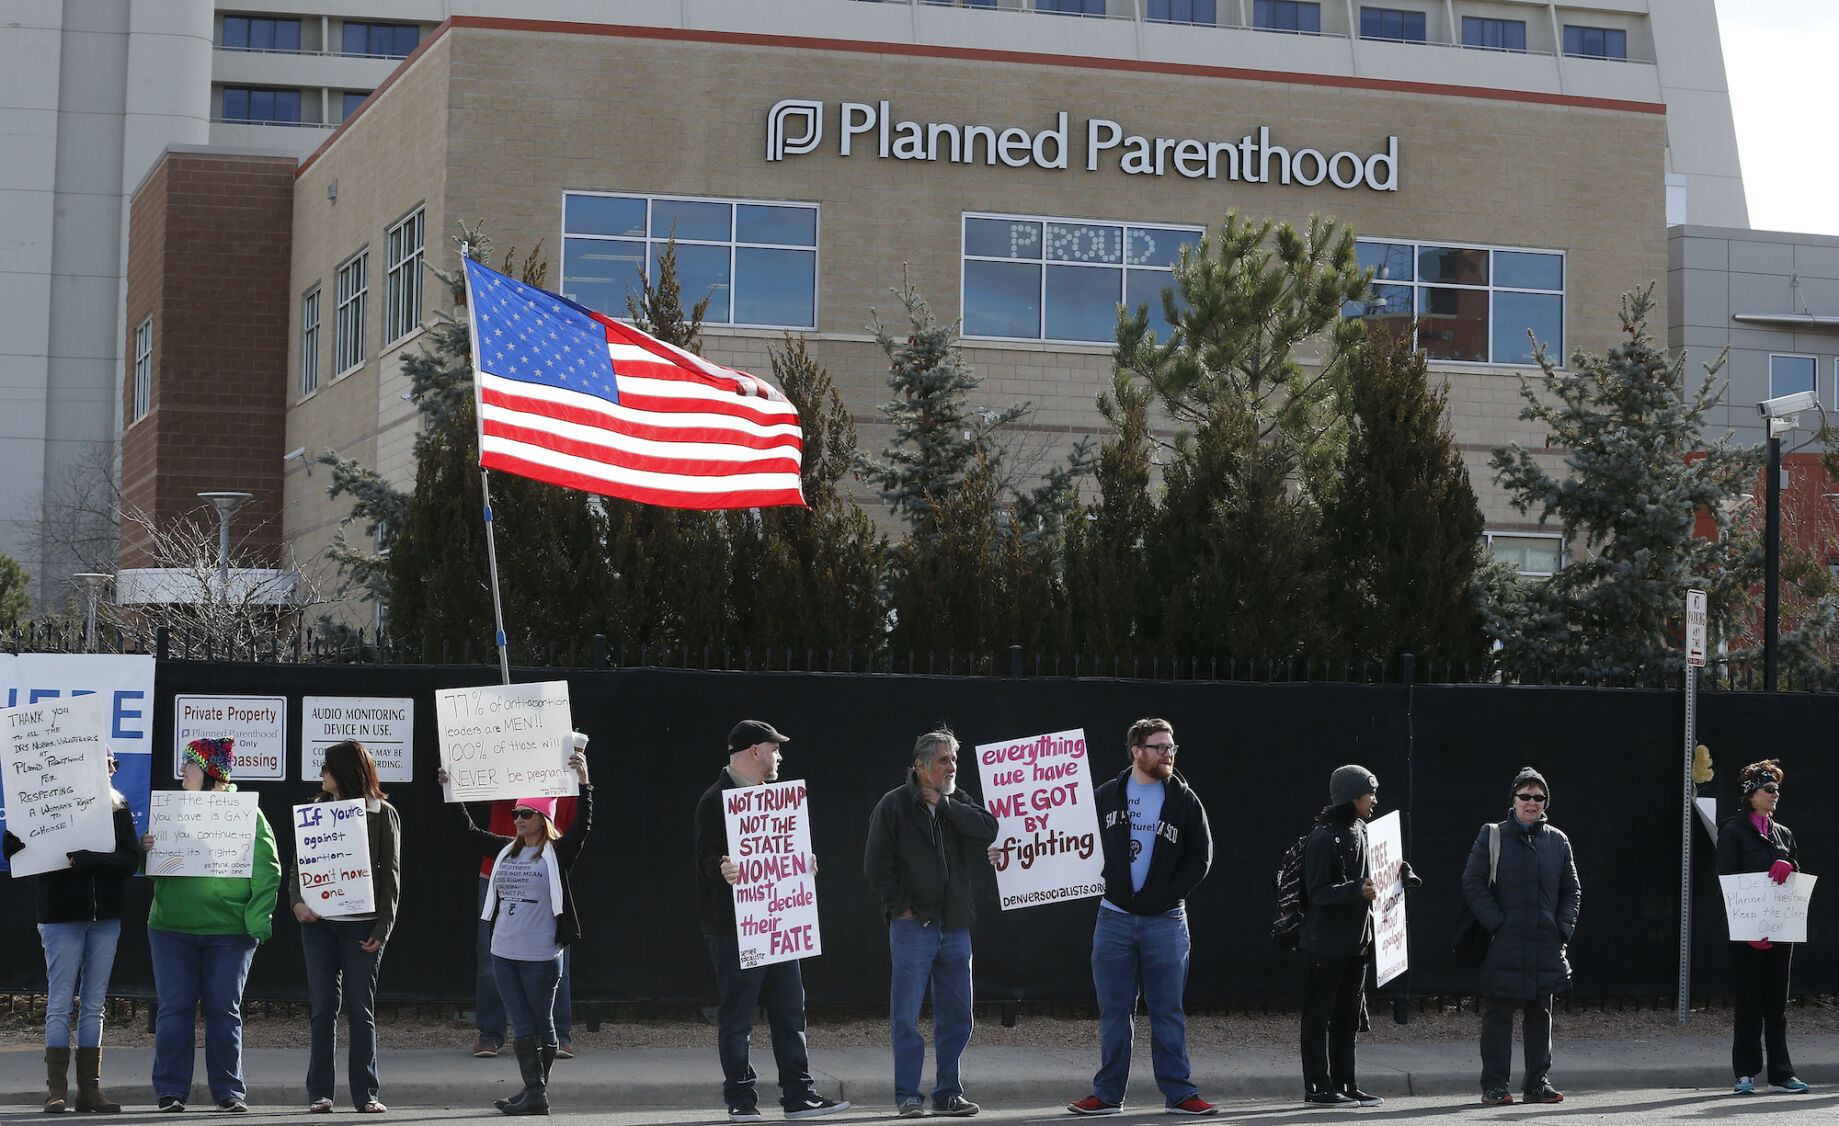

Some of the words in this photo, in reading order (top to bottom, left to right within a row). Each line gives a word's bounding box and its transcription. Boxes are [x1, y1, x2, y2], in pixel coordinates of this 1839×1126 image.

[839, 100, 1069, 169] Planned
[1086, 118, 1399, 192] Parenthood
[1010, 224, 1156, 265] PROUD
[1688, 611, 1706, 626] PARKING
[312, 707, 342, 720] AUDIO
[345, 708, 406, 721] MONITORING
[444, 690, 484, 718] 77%
[490, 696, 502, 713] of
[503, 697, 568, 711] anti-abortion
[8, 710, 45, 727] THANK
[184, 705, 223, 721] Private
[228, 706, 277, 724] Property
[45, 727, 61, 735] THE
[192, 729, 227, 738] Planned
[229, 729, 278, 738] Parenthood
[324, 723, 356, 735] DEVICE
[360, 724, 370, 735] IN
[373, 725, 393, 737] USE.
[444, 724, 482, 738] leaders
[485, 724, 501, 735] are
[504, 714, 543, 733] MEN!!
[239, 740, 258, 748] Only
[375, 748, 392, 757] MAY
[394, 748, 403, 757] BE
[448, 739, 487, 762] 100%
[493, 740, 506, 754] of
[510, 740, 538, 752] those
[542, 737, 560, 749] will
[982, 735, 1085, 766] everything
[449, 767, 500, 787] NEVER
[507, 768, 524, 783] be
[527, 767, 569, 783] pregnant
[993, 768, 1025, 787] we
[1033, 762, 1078, 781] have
[18, 786, 74, 804] RESPECTING
[153, 794, 173, 807] If
[178, 793, 203, 806] the
[207, 794, 240, 808] fetus
[728, 790, 754, 815] NOT
[755, 786, 807, 812] TRUMP
[988, 792, 1029, 819] WE
[1031, 782, 1079, 811] GOT
[1128, 798, 1141, 806] nd
[29, 808, 36, 817] A
[152, 813, 171, 825] you
[177, 813, 202, 821] save
[211, 811, 220, 821] is
[224, 809, 252, 824] GAY
[297, 806, 323, 828] If
[740, 814, 769, 835] NOT
[771, 815, 797, 834] THE
[1024, 813, 1049, 833] BY
[151, 830, 168, 841] Will
[173, 830, 190, 844] you
[197, 830, 237, 840] continue
[238, 831, 252, 840] to
[304, 832, 346, 849] against
[740, 835, 795, 856] STATE
[150, 848, 184, 859] Protect
[187, 847, 201, 857] its
[996, 829, 1094, 872] fighting
[1370, 840, 1389, 871] FREE
[301, 868, 337, 887] Don't
[340, 868, 370, 881] have
[321, 888, 345, 900] one
[737, 879, 775, 903] must
[768, 881, 813, 913] decide
[1376, 911, 1398, 936] without
[1732, 908, 1757, 919] Keep
[740, 913, 782, 936] their
[770, 924, 814, 955] FATE
